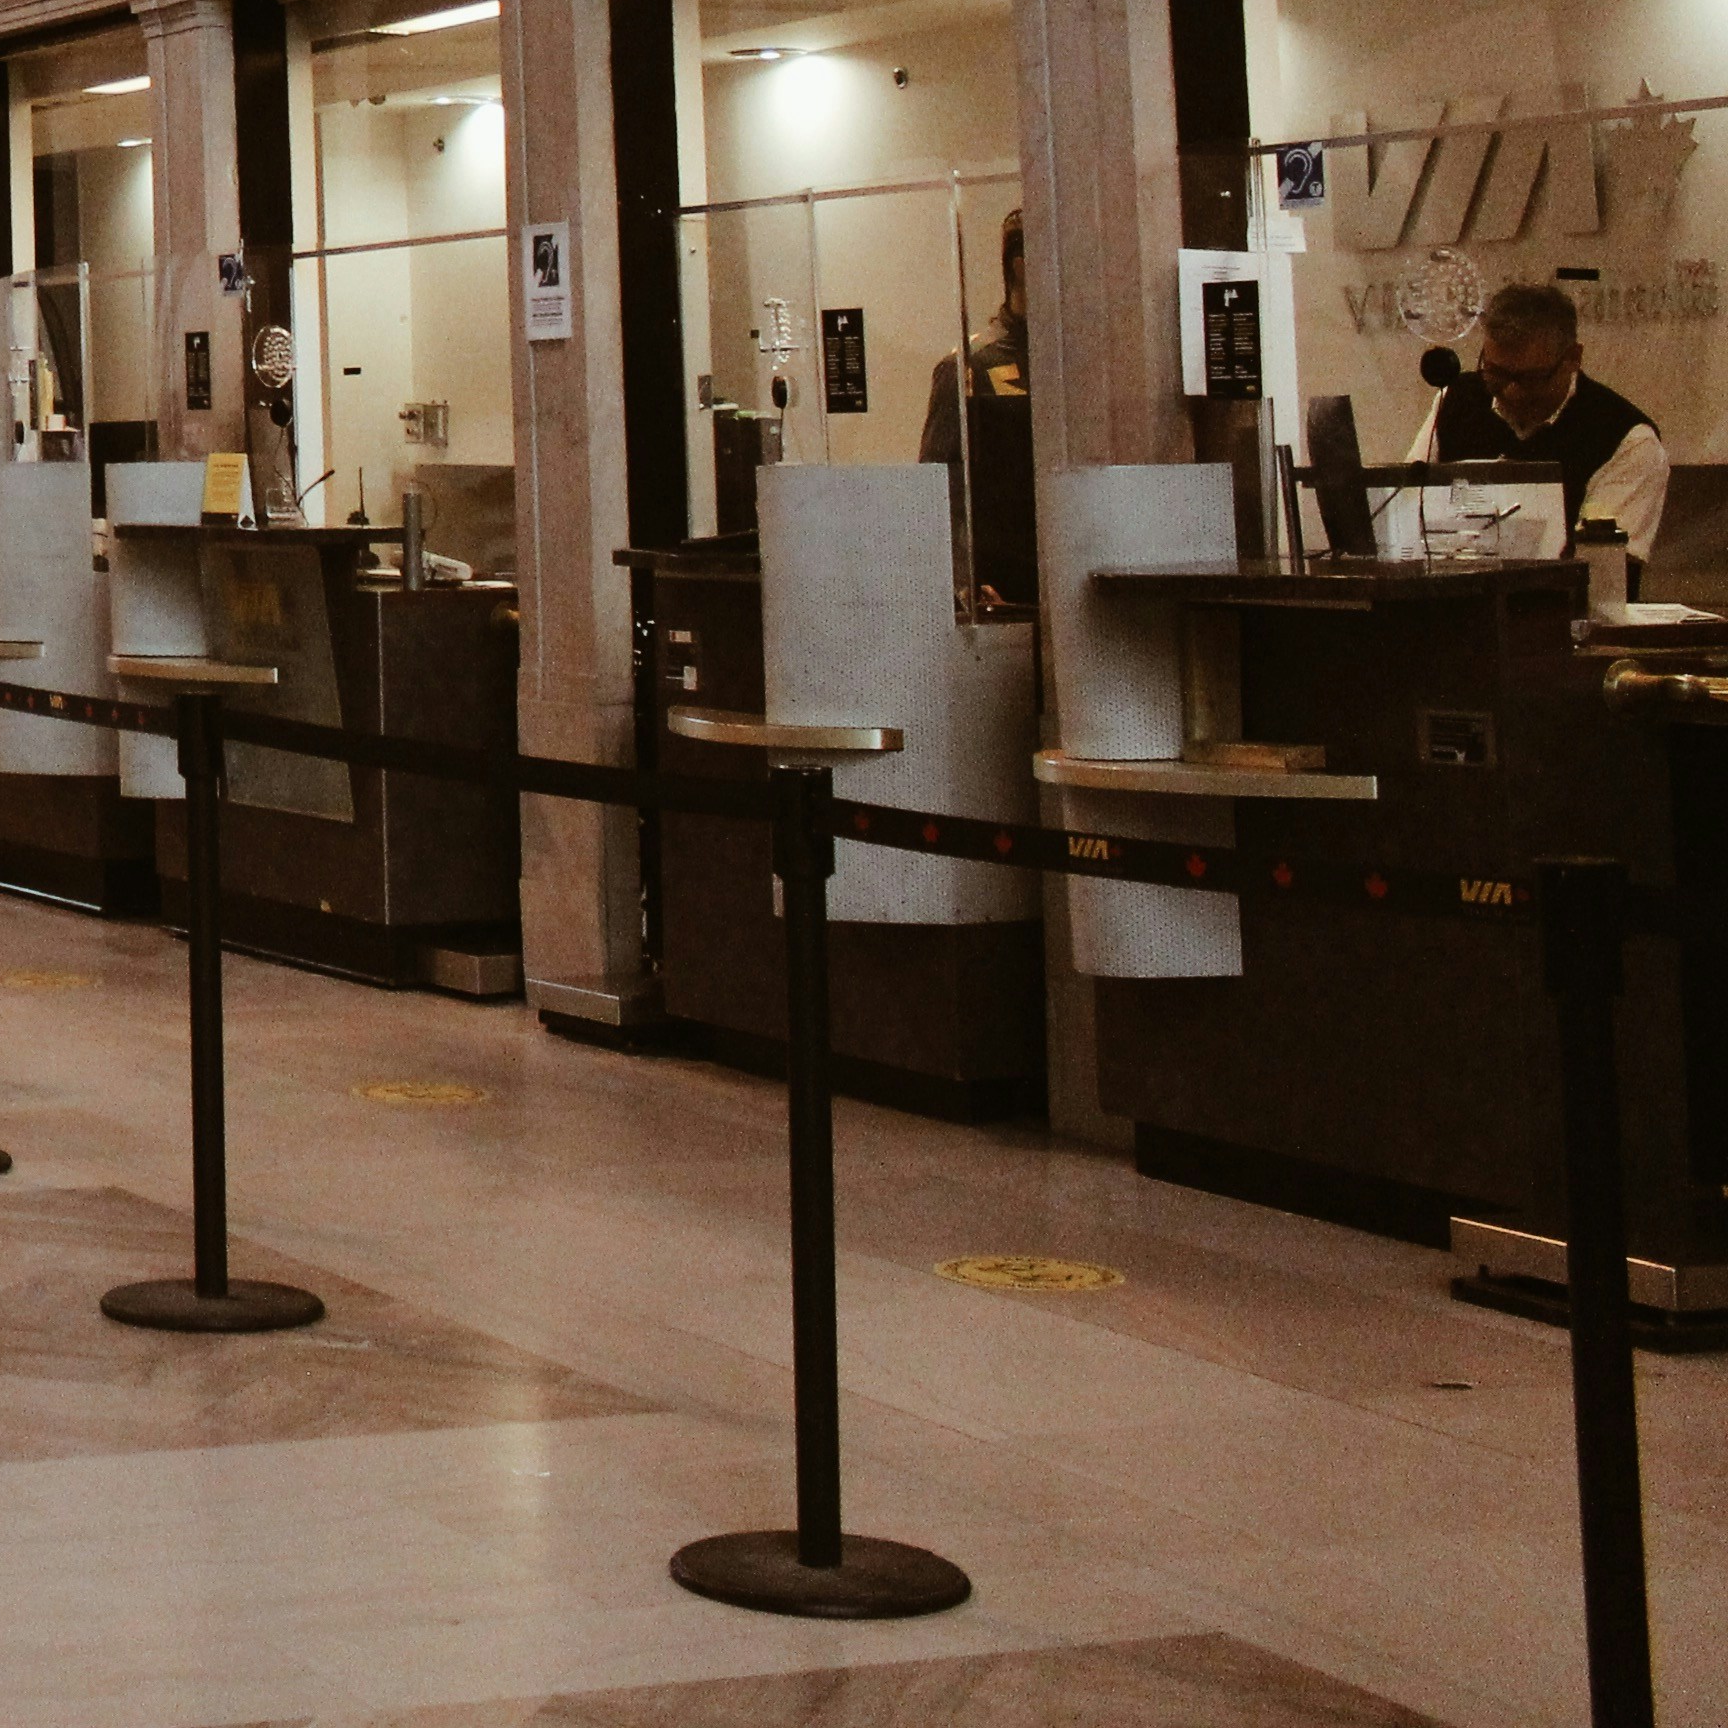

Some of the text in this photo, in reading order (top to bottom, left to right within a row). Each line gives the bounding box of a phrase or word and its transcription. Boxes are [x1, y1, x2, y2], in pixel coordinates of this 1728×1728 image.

[1331, 84, 1604, 252] VIA
[1068, 836, 1109, 860] VIA
[1459, 878, 1513, 906] VIA
